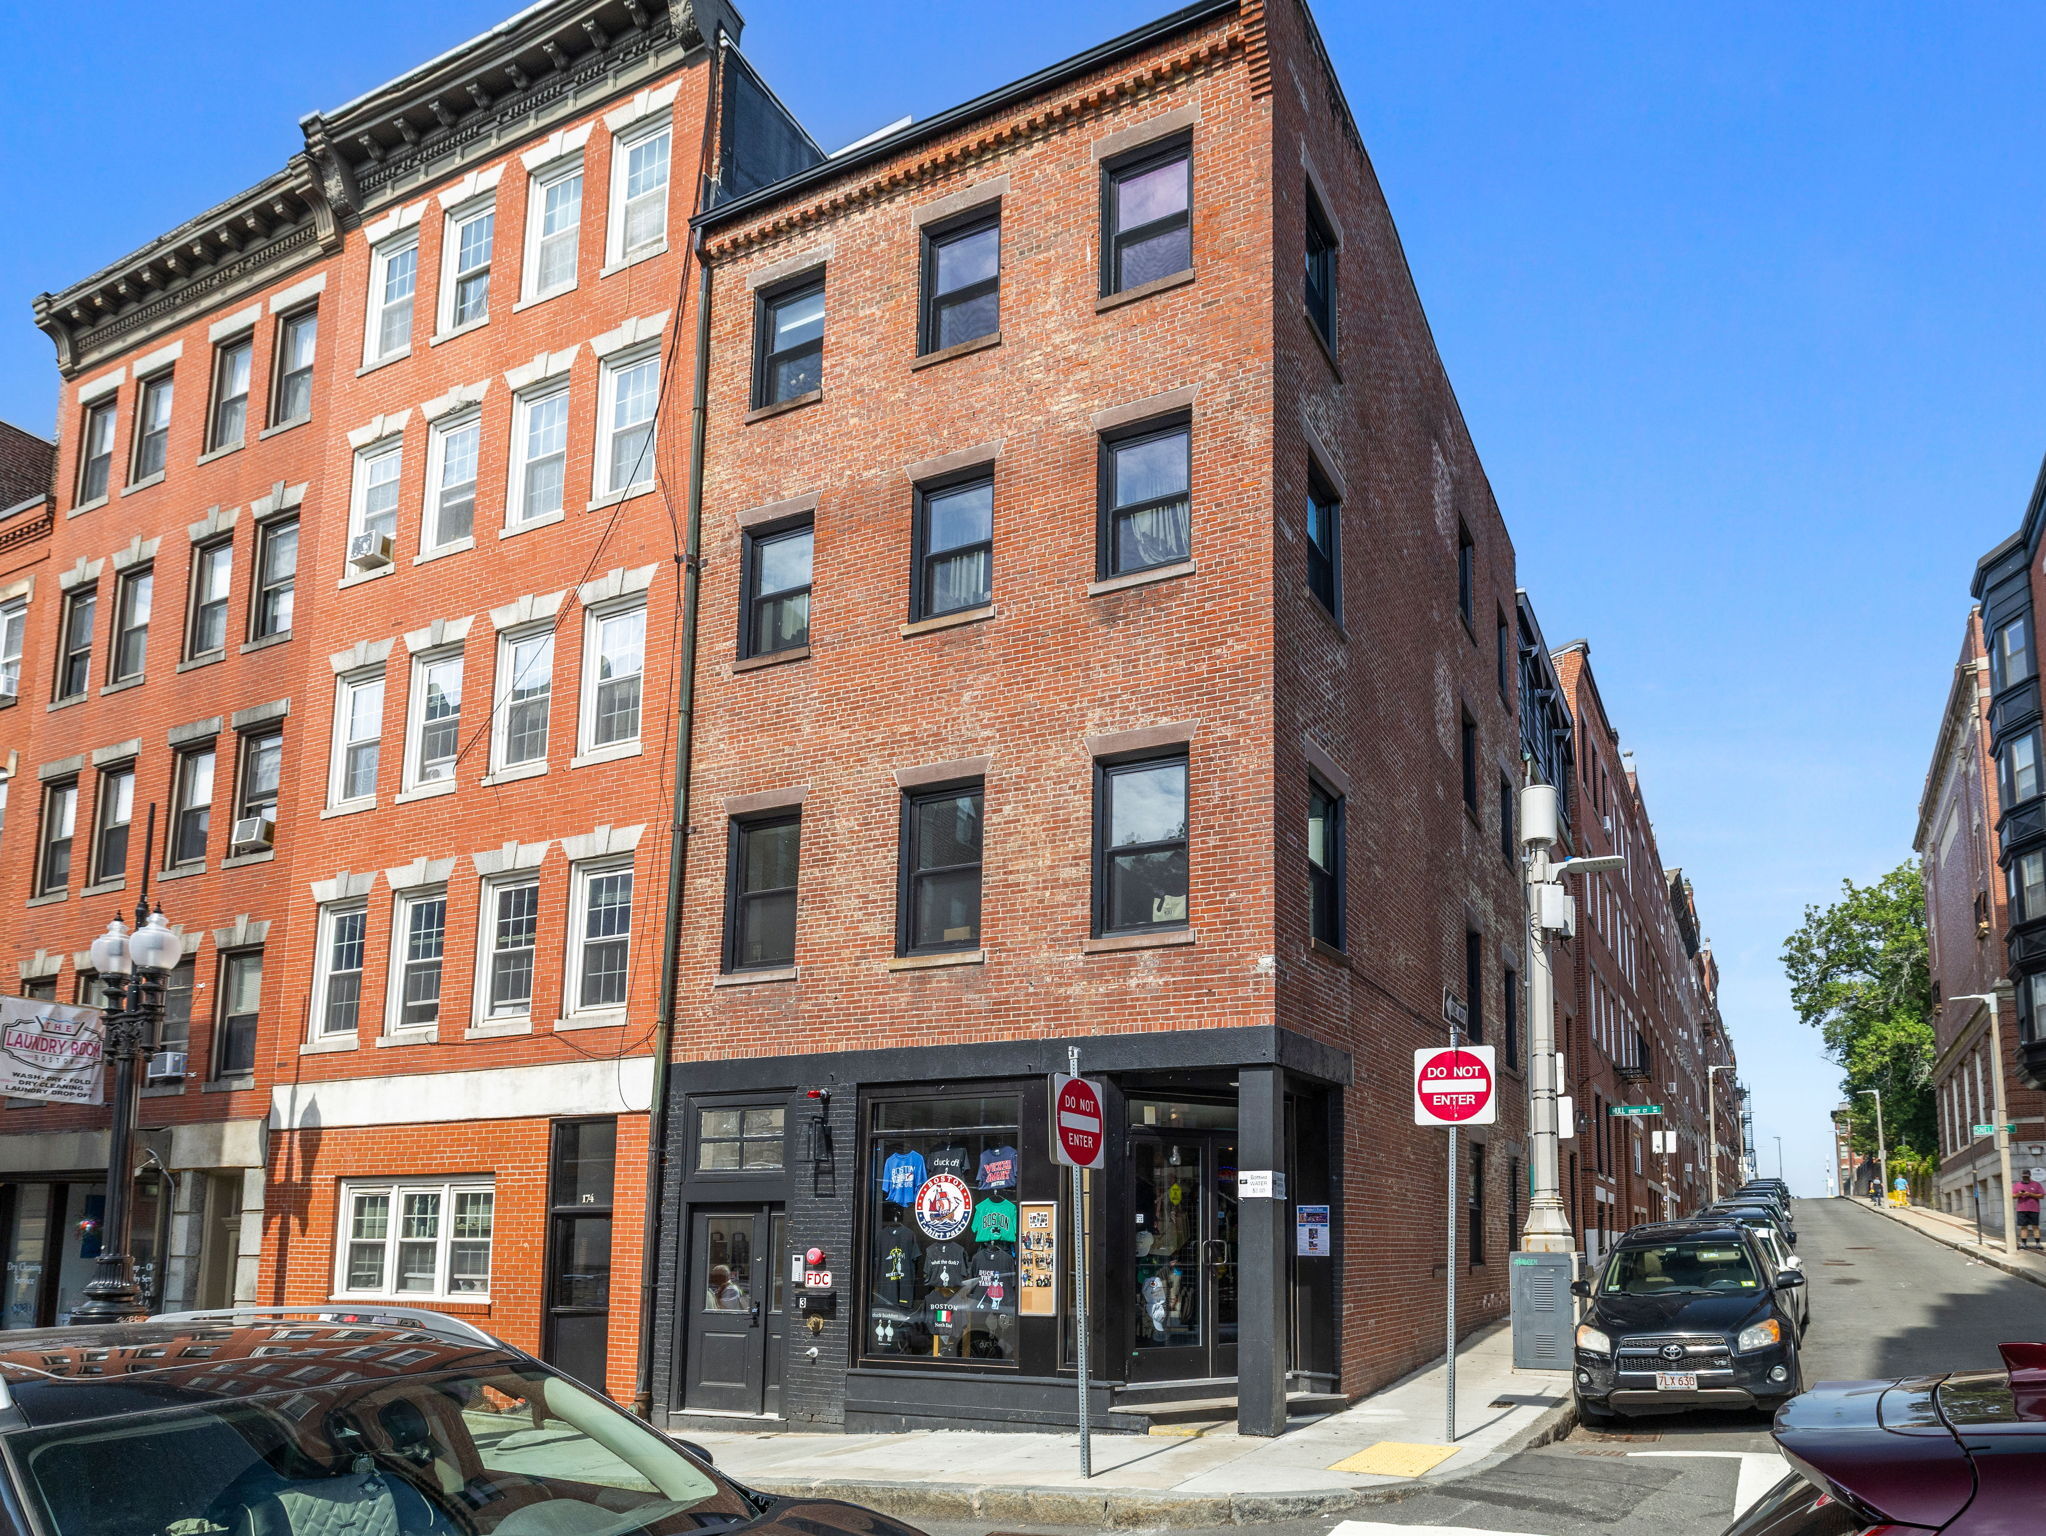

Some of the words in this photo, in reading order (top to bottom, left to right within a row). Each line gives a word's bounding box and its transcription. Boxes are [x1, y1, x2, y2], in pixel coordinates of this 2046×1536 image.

[46, 1022, 72, 1032] THE
[6, 1031, 67, 1054] LAUNDRY
[71, 1041, 101, 1058] ROOM
[12, 1072, 40, 1080] WASH
[1427, 1067, 1447, 1078] DO
[1453, 1066, 1481, 1077] NOT
[5, 1085, 48, 1095] LAUNDRY
[39, 1082, 84, 1091] CLEANING
[1065, 1094, 1076, 1109] DO
[1080, 1098, 1094, 1113] NOT
[1433, 1094, 1475, 1105] ENTER
[1612, 1107, 1626, 1115] HULL
[1068, 1132, 1093, 1148] ENTER
[933, 1158, 949, 1166] duck
[927, 1176, 966, 1191] BOSTON
[582, 1193, 594, 1203] 174
[982, 1213, 1009, 1230] BOSTON
[807, 1273, 829, 1285] FDC
[800, 1298, 806, 1307] 3
[1659, 1376, 1675, 1386] 7LX
